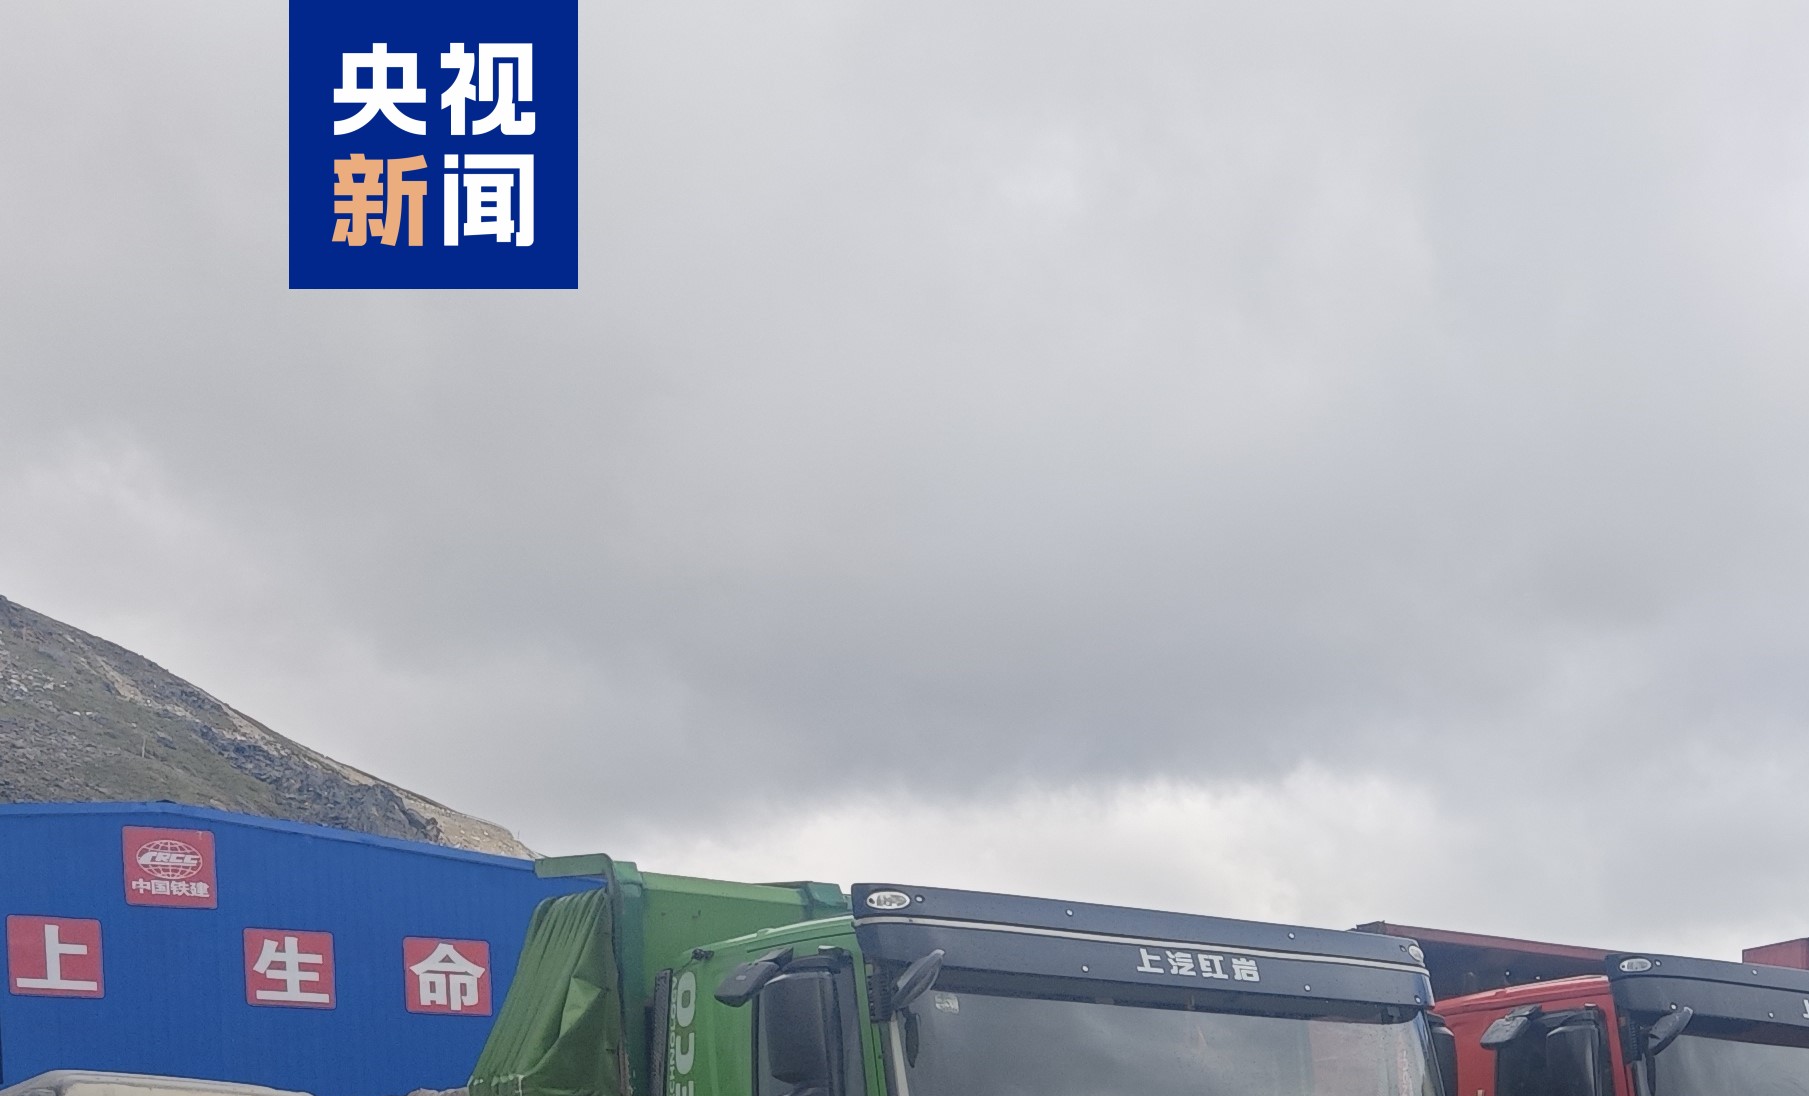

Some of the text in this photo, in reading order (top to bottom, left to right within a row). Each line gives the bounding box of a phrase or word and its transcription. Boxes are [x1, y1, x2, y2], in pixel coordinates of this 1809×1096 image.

[131, 877, 210, 898] 中国铁建
[16, 924, 98, 991] 上
[1137, 948, 1260, 982] 上汽红岩
